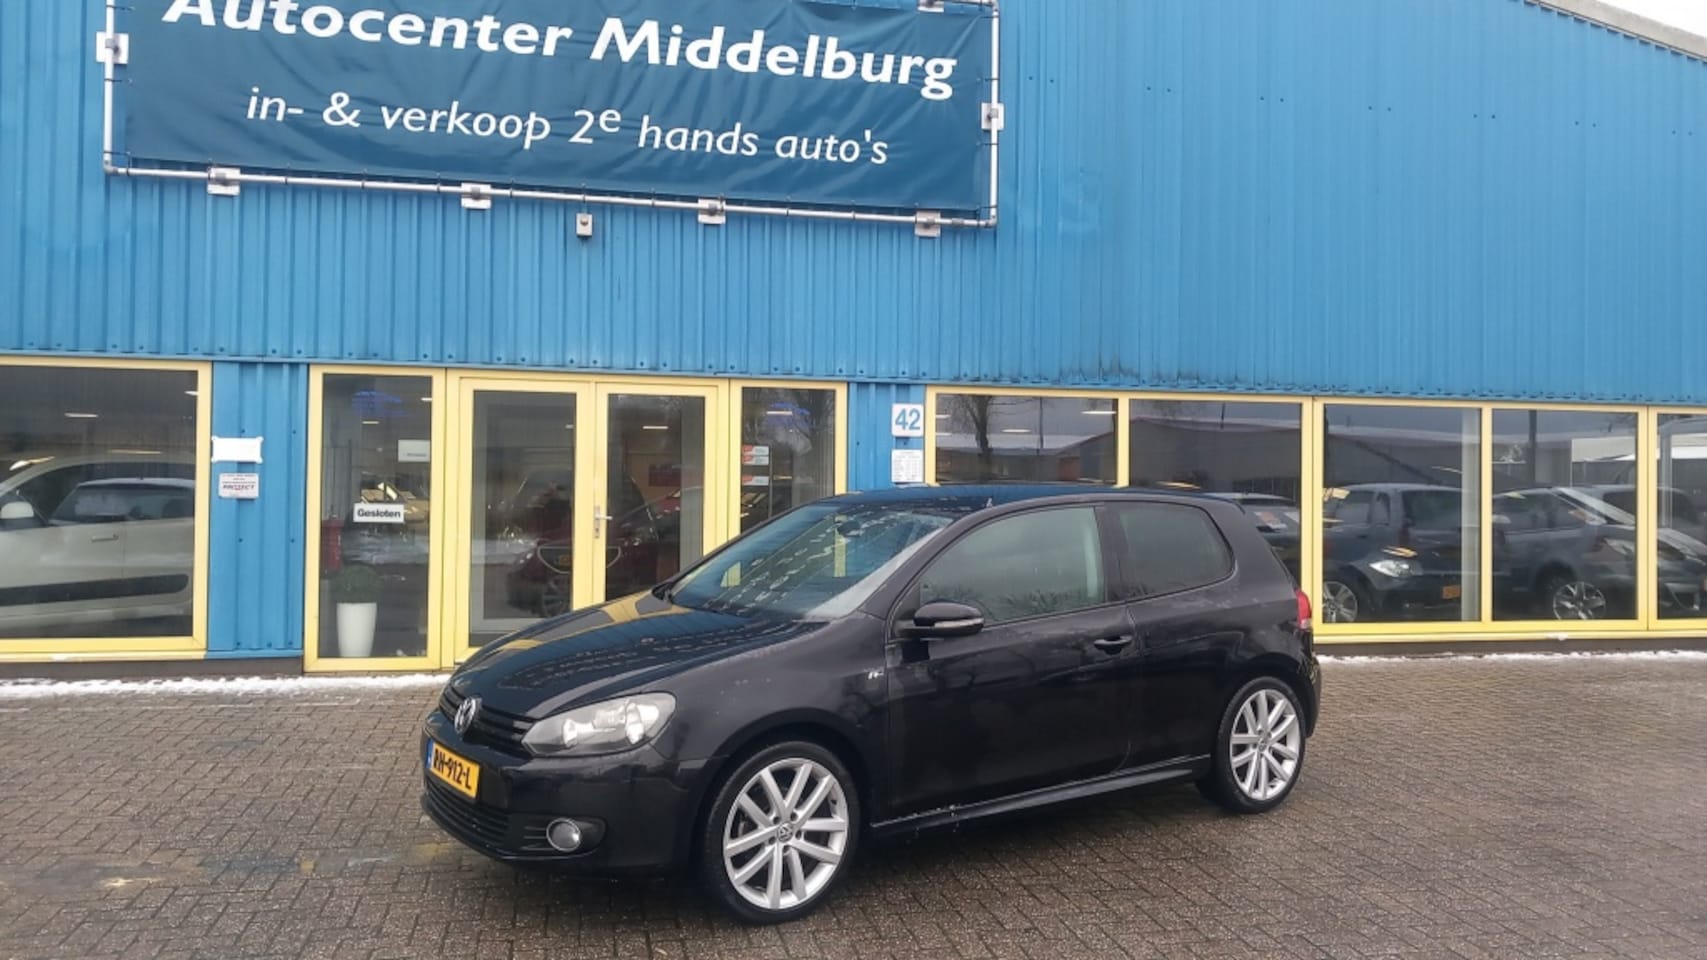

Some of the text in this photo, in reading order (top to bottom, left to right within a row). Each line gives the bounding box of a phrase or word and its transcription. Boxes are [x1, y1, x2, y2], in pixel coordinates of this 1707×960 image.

[161, 0, 958, 100] Autocenter Middelburg
[246, 87, 889, 165] in- & verkoop 2e hands auto's
[895, 408, 921, 431] 42
[357, 508, 401, 518] Gesloten
